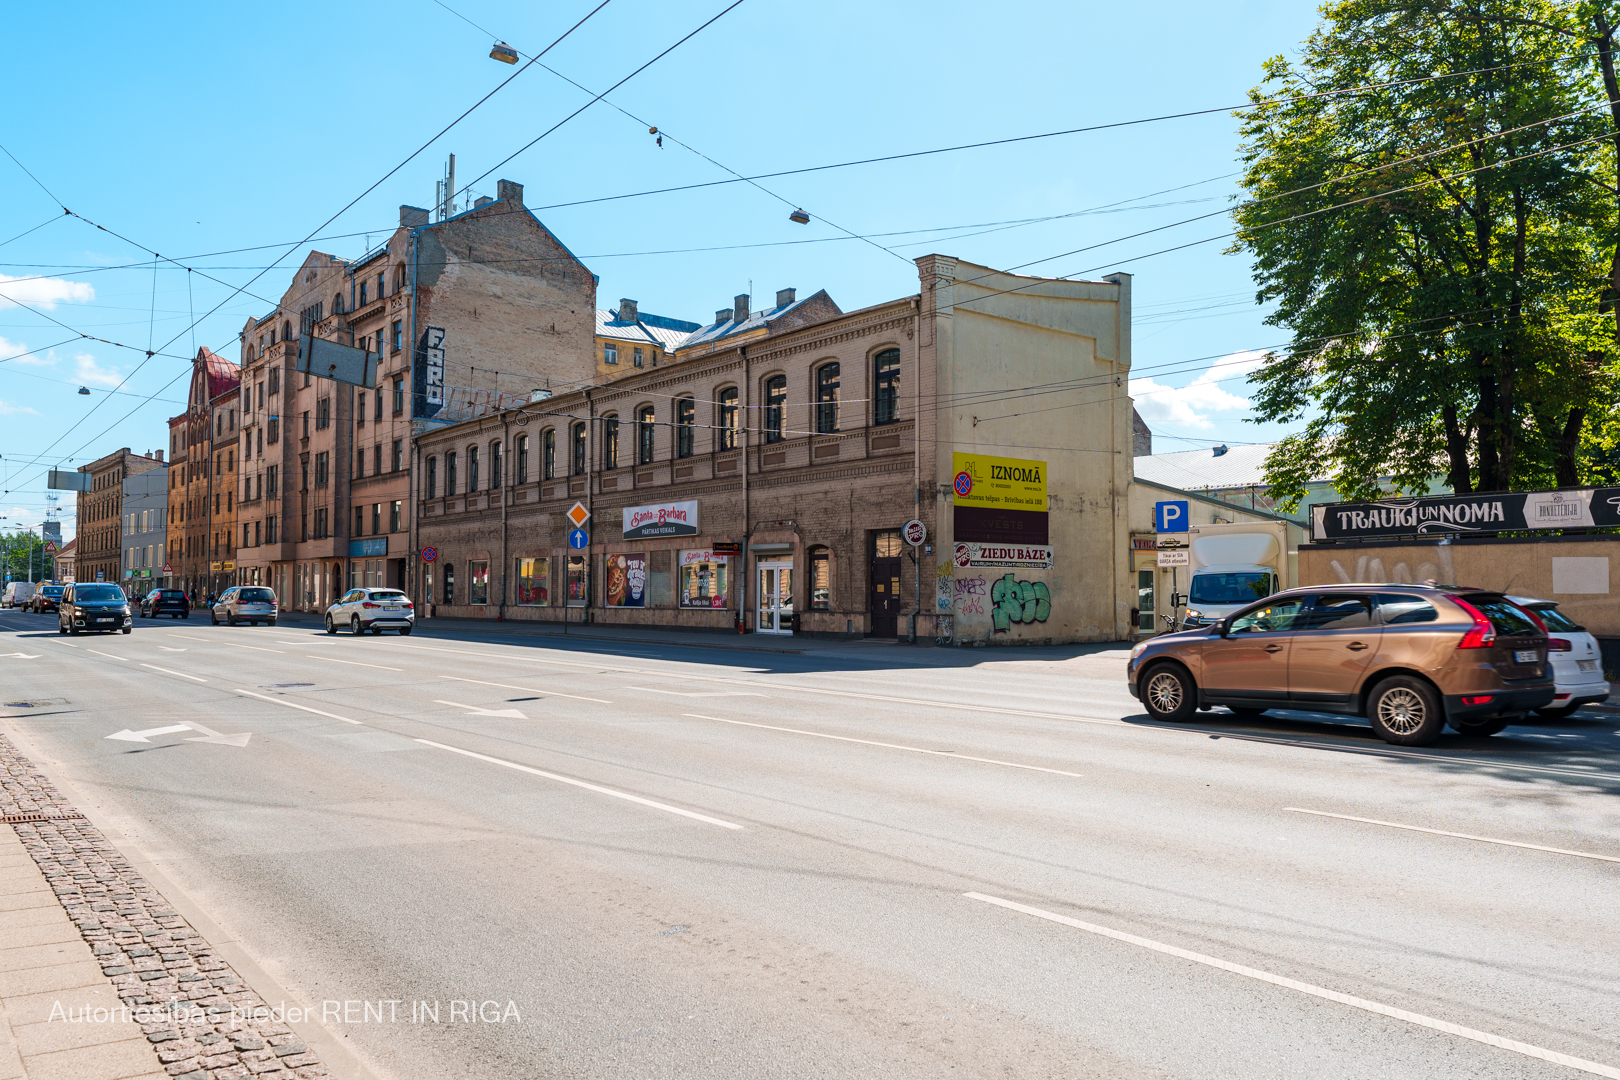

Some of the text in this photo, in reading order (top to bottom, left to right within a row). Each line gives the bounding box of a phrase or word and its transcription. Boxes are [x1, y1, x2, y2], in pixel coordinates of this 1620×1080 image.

[991, 465, 1041, 483] IZNOMĀ
[631, 506, 686, 528] Santa Barbara
[980, 519, 1024, 530] KVESTS
[1163, 504, 1181, 529] P
[1337, 502, 1504, 530] TRAUKI UN NOMA
[980, 548, 1015, 559] ZIEDU
[1017, 547, 1046, 560] BĀZE
[1133, 540, 1157, 549] VEIKA
